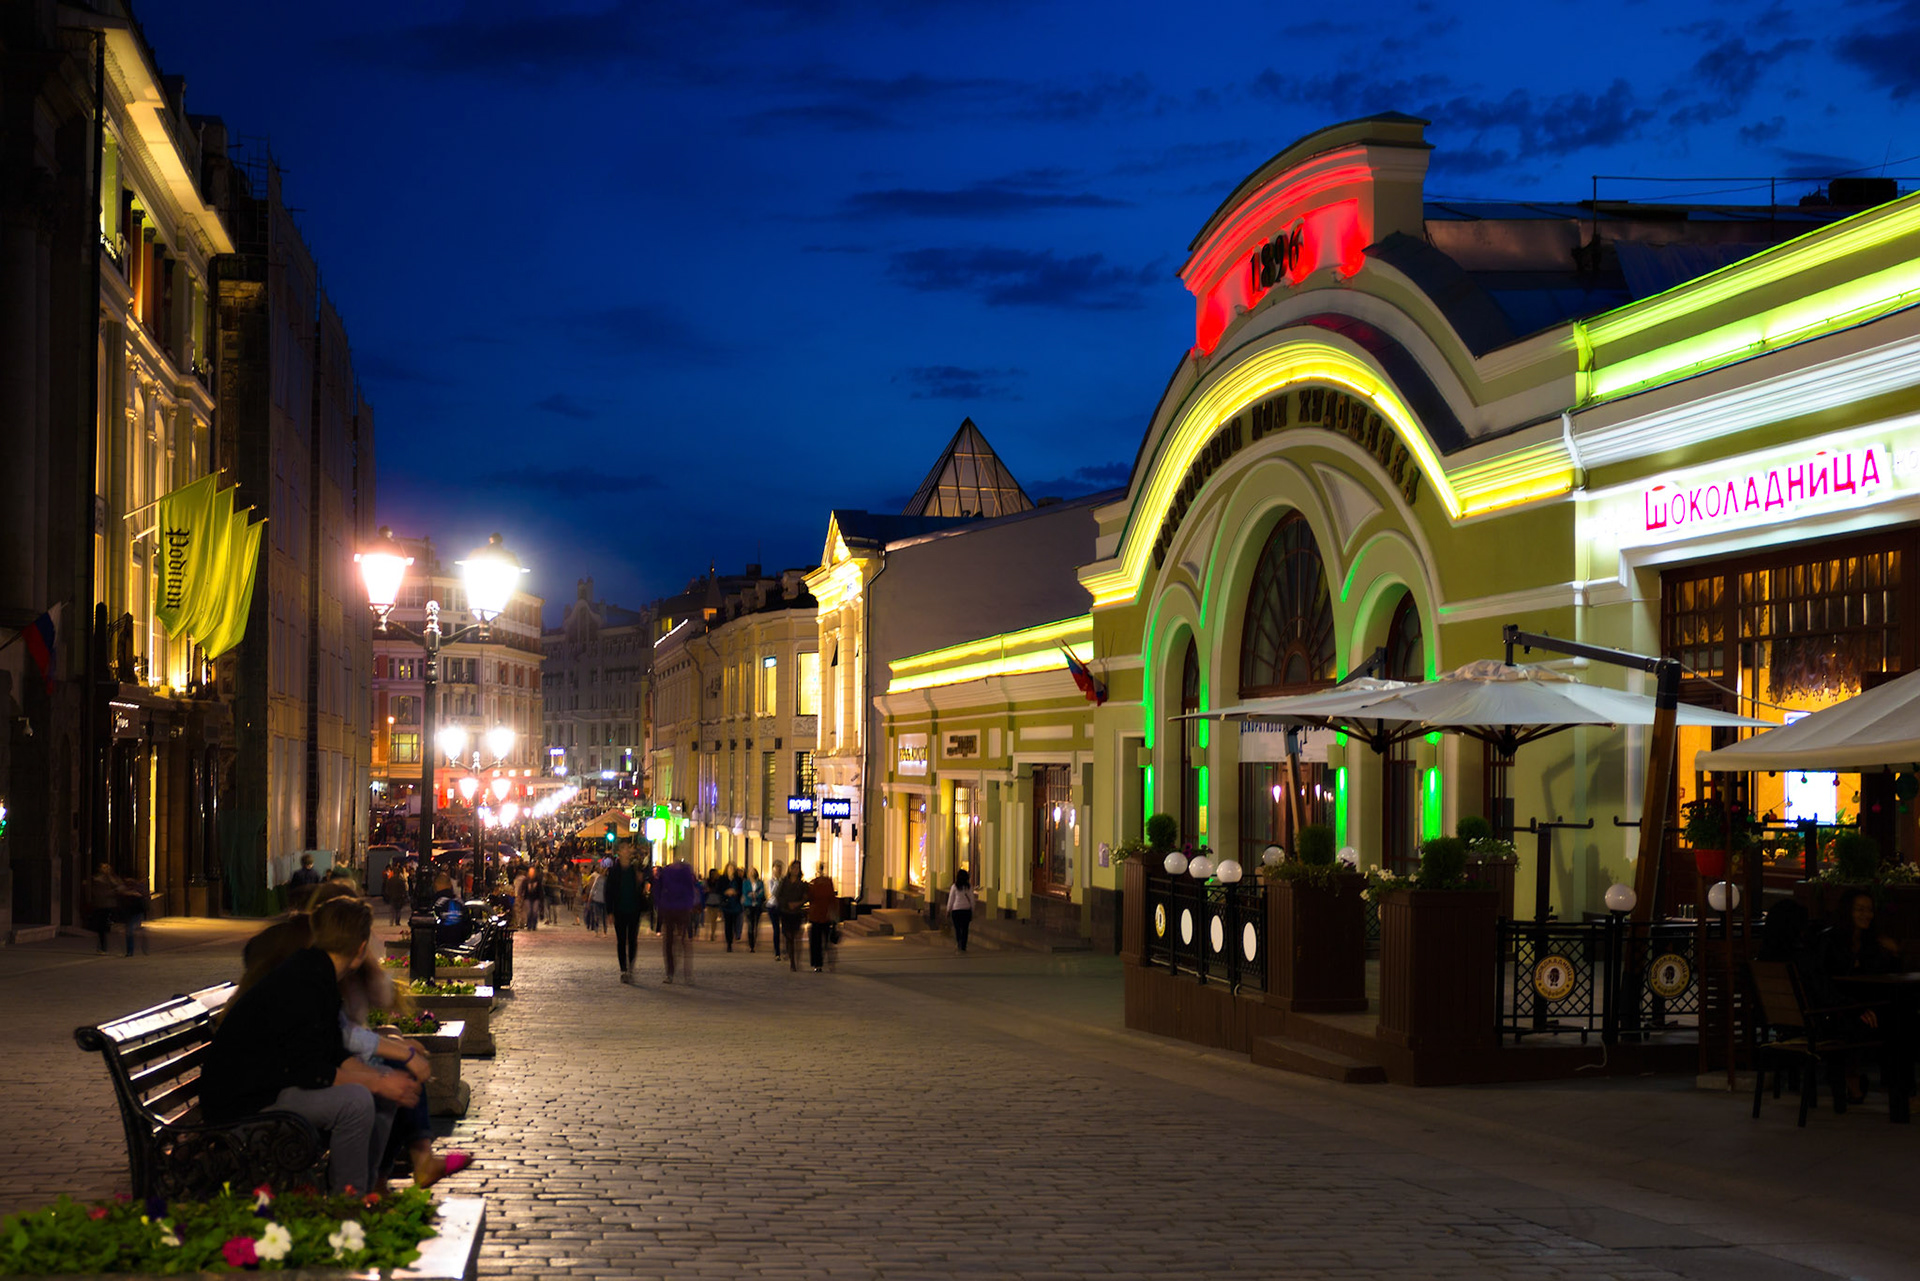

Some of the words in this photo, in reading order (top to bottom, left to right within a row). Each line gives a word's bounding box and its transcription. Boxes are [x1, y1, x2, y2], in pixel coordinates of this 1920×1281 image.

[1250, 218, 1304, 294] 1896
[1251, 395, 1288, 440] ДОМ
[1298, 389, 1422, 506] ХУДОЖНИКА
[1645, 449, 1880, 531] ШОКОЛАДНИЦА
